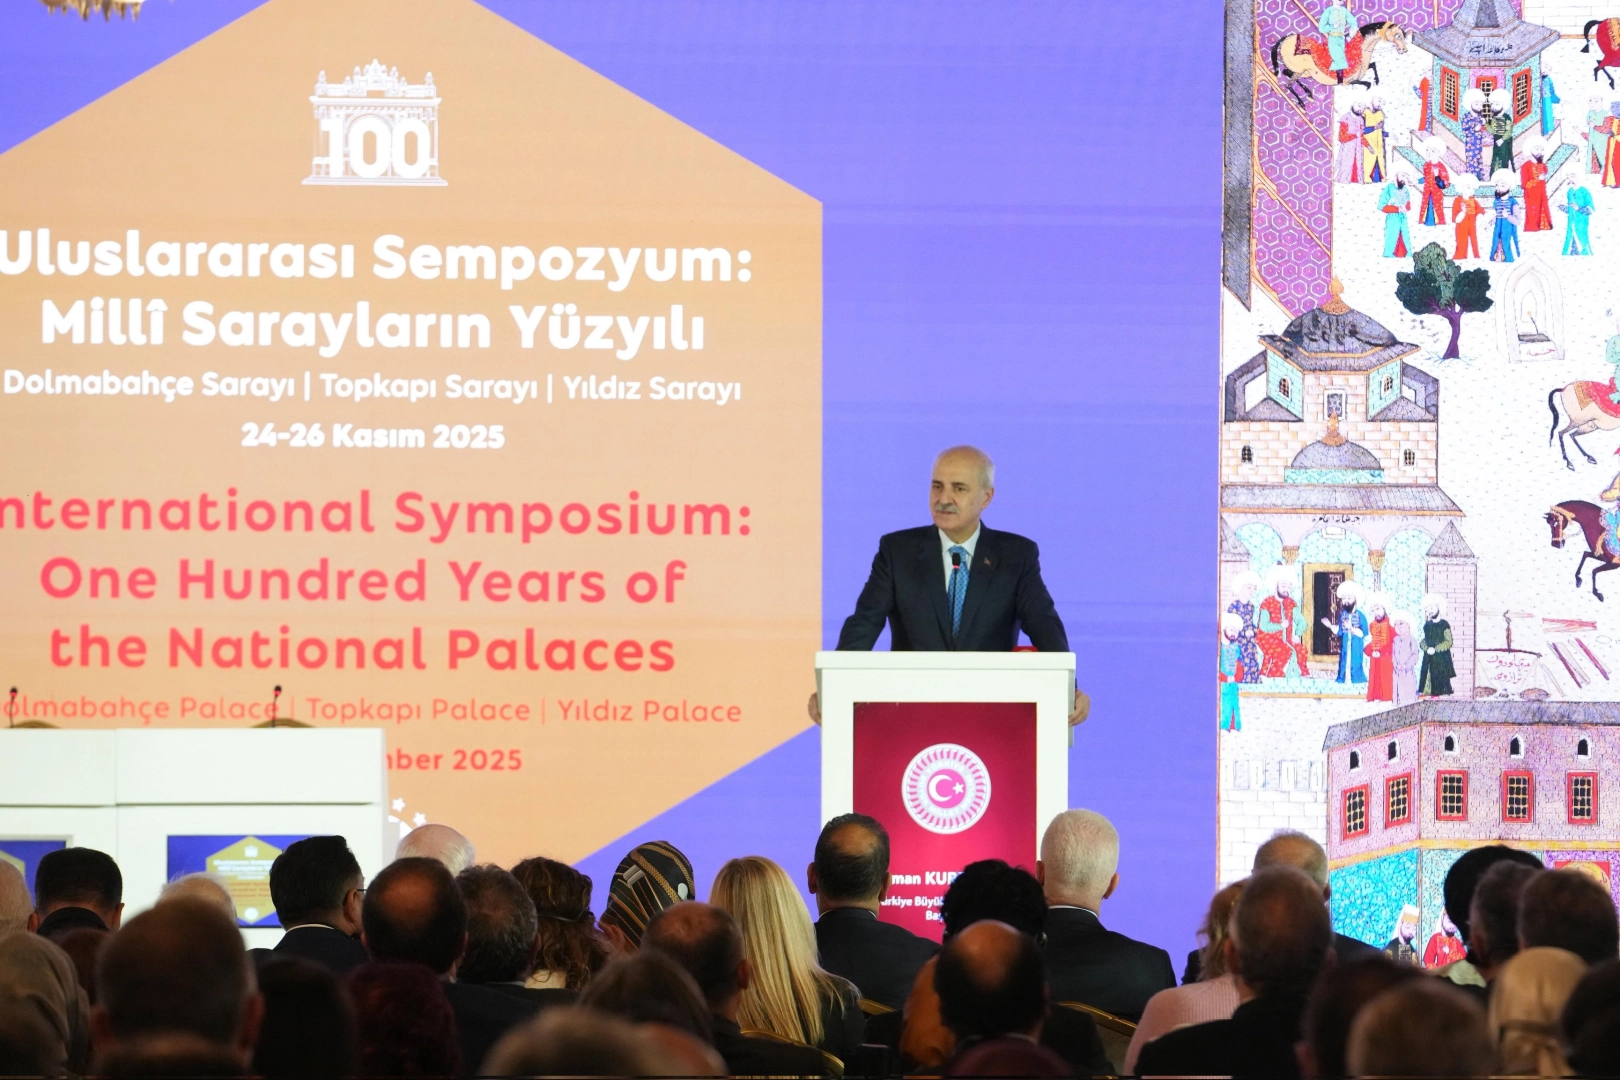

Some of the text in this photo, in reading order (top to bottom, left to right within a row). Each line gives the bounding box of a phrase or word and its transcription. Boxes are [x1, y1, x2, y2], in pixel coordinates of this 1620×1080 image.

[320, 117, 430, 178] 100
[0, 228, 752, 292] Uluslararası Sempozyum:
[42, 296, 704, 361] Millî Sarayların Yüzyılı
[4, 369, 194, 403] Dolmabahçe
[201, 371, 295, 402] Sarayı
[319, 372, 437, 403] Topkapı
[445, 374, 538, 404] Sarayı
[563, 374, 642, 400] Yıldız
[649, 376, 741, 406] Sarayı
[241, 422, 506, 449] 24-26 Kasım 2025
[0, 486, 751, 545] nternational Symposium:
[39, 556, 687, 604] One Hundred Years of
[50, 623, 675, 673] the National Palaces
[0, 694, 171, 726] olmabahçe
[179, 695, 280, 721] Palace
[305, 696, 422, 725] Topkapı
[431, 697, 531, 722] Palace
[556, 697, 634, 723] Yıldız
[642, 698, 743, 723] Palace
[451, 747, 524, 773] 2025
[891, 873, 922, 886] man
